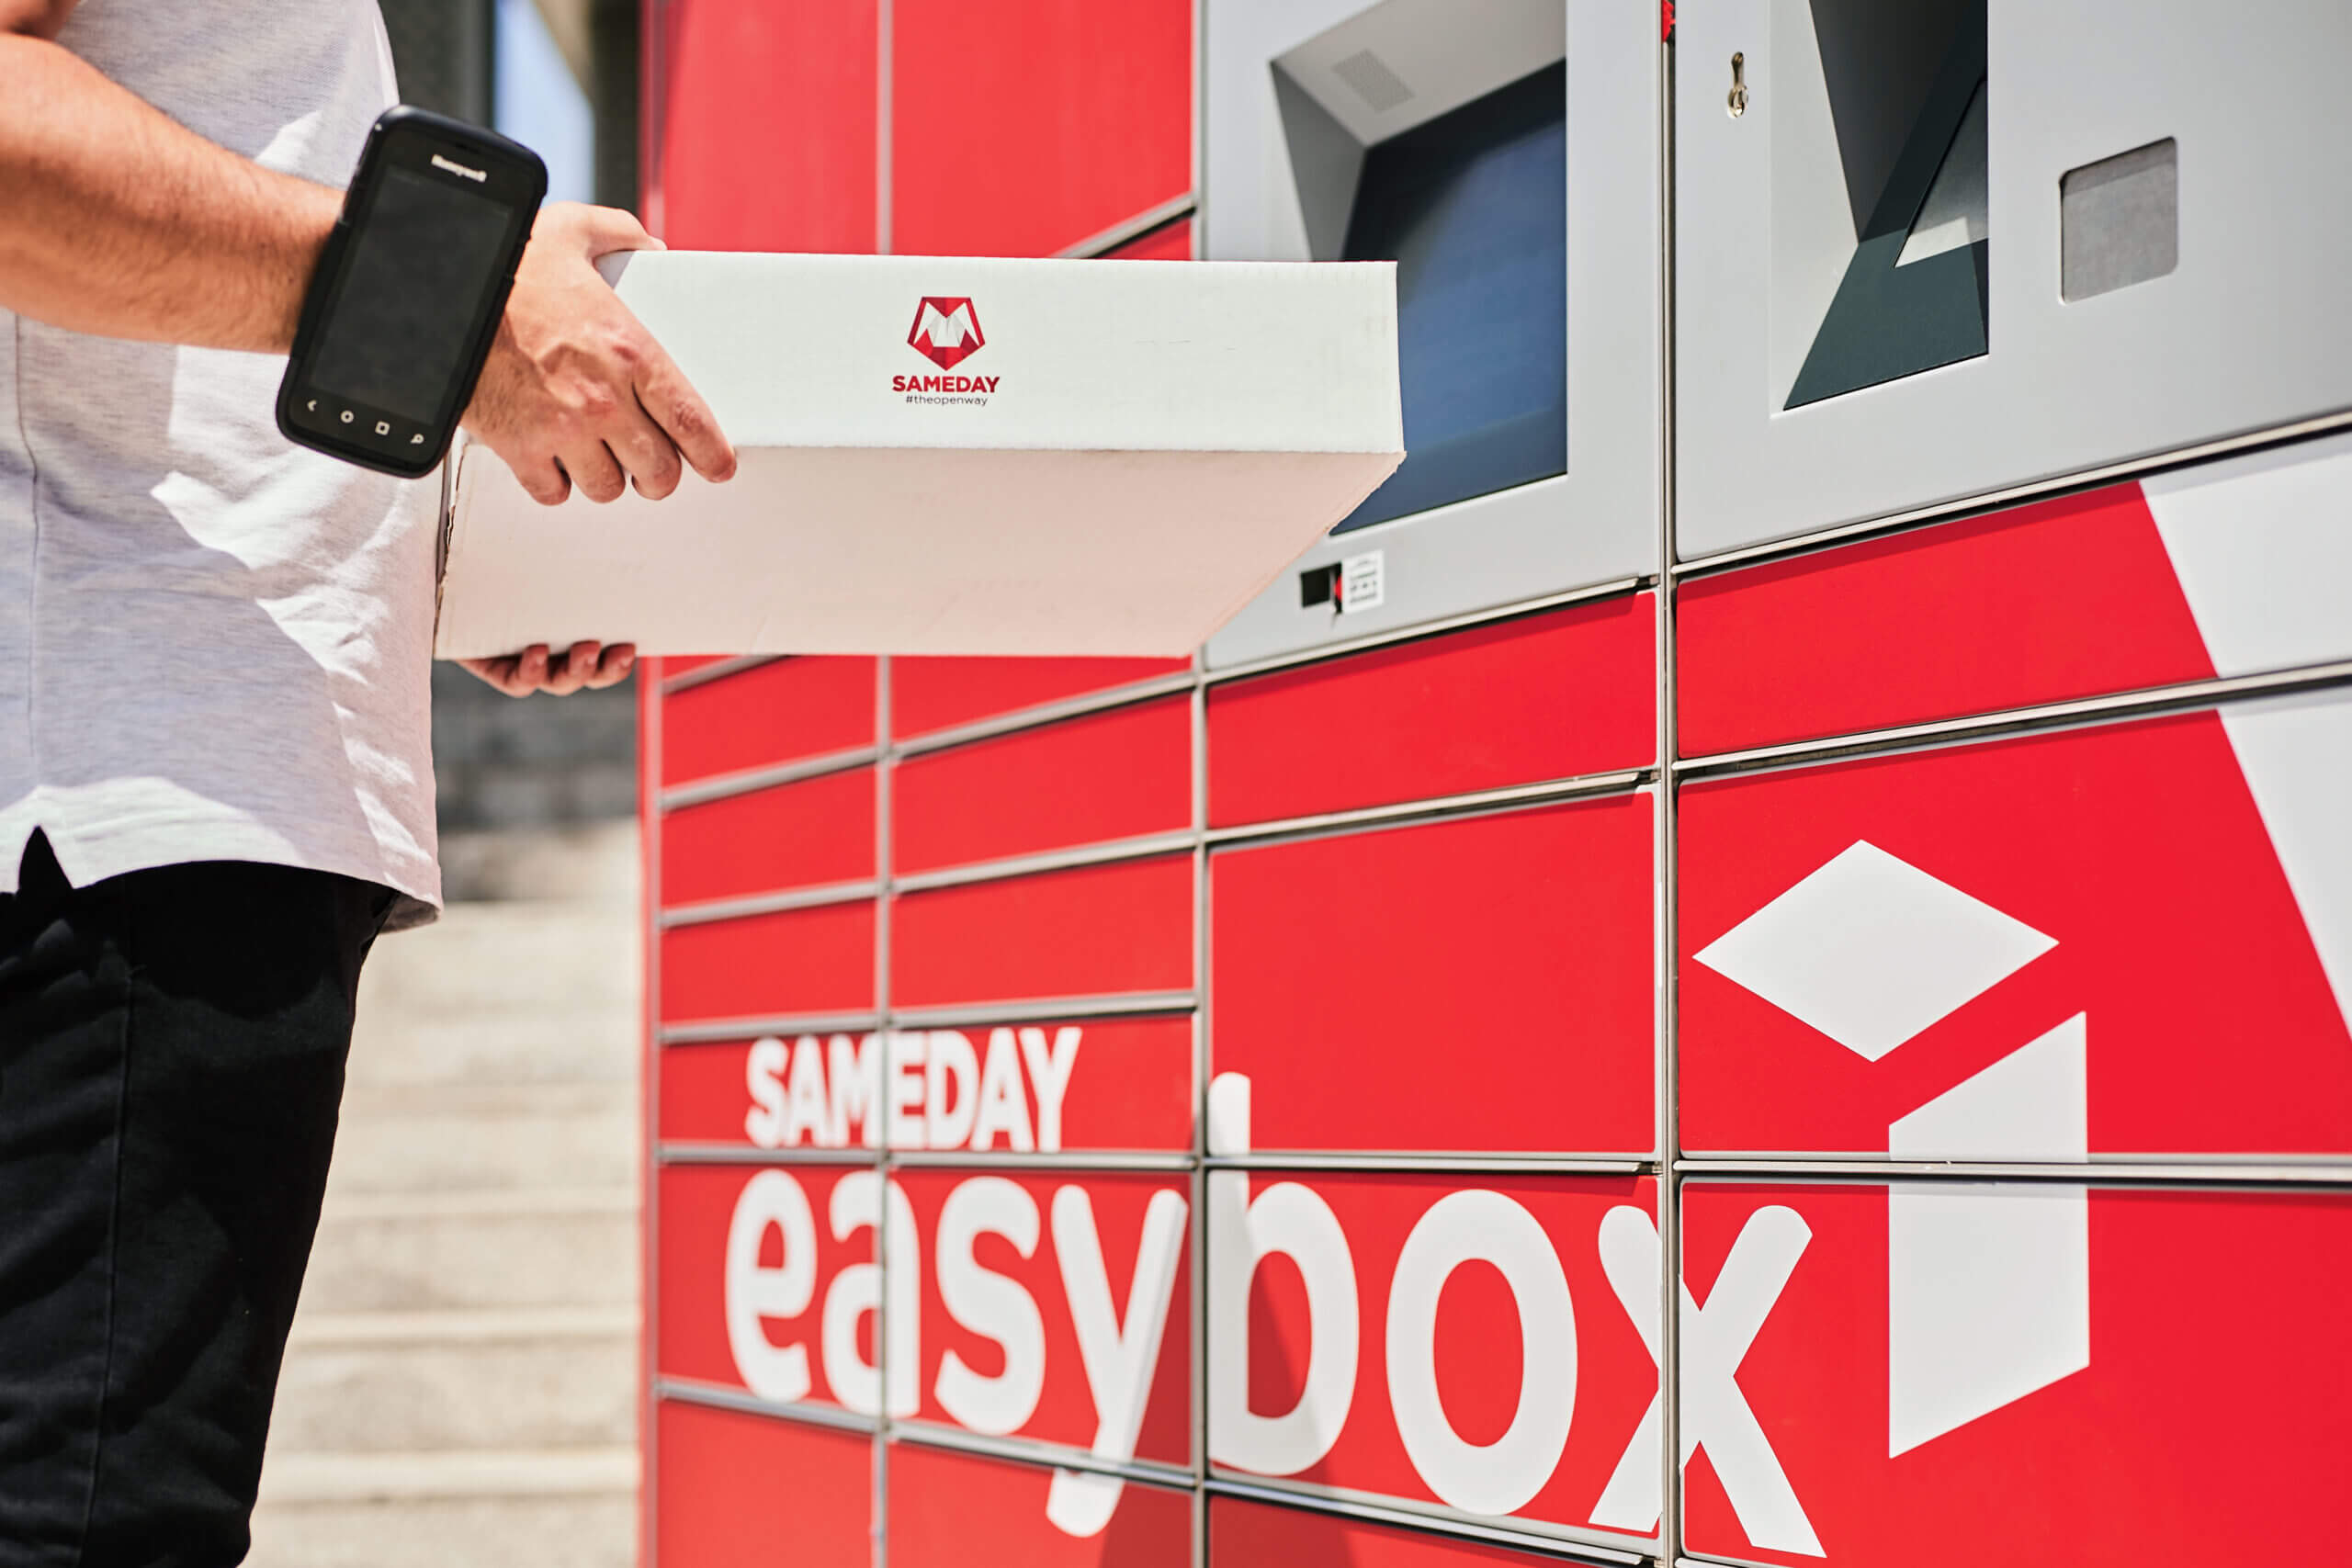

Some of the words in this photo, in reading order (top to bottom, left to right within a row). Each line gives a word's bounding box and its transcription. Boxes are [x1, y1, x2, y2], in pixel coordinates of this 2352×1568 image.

[892, 375, 1001, 393] SAMEDAY
[906, 395, 989, 406] #theopenway
[745, 1027, 1082, 1153] SAMEDAY
[724, 1071, 1826, 1559] easybox
